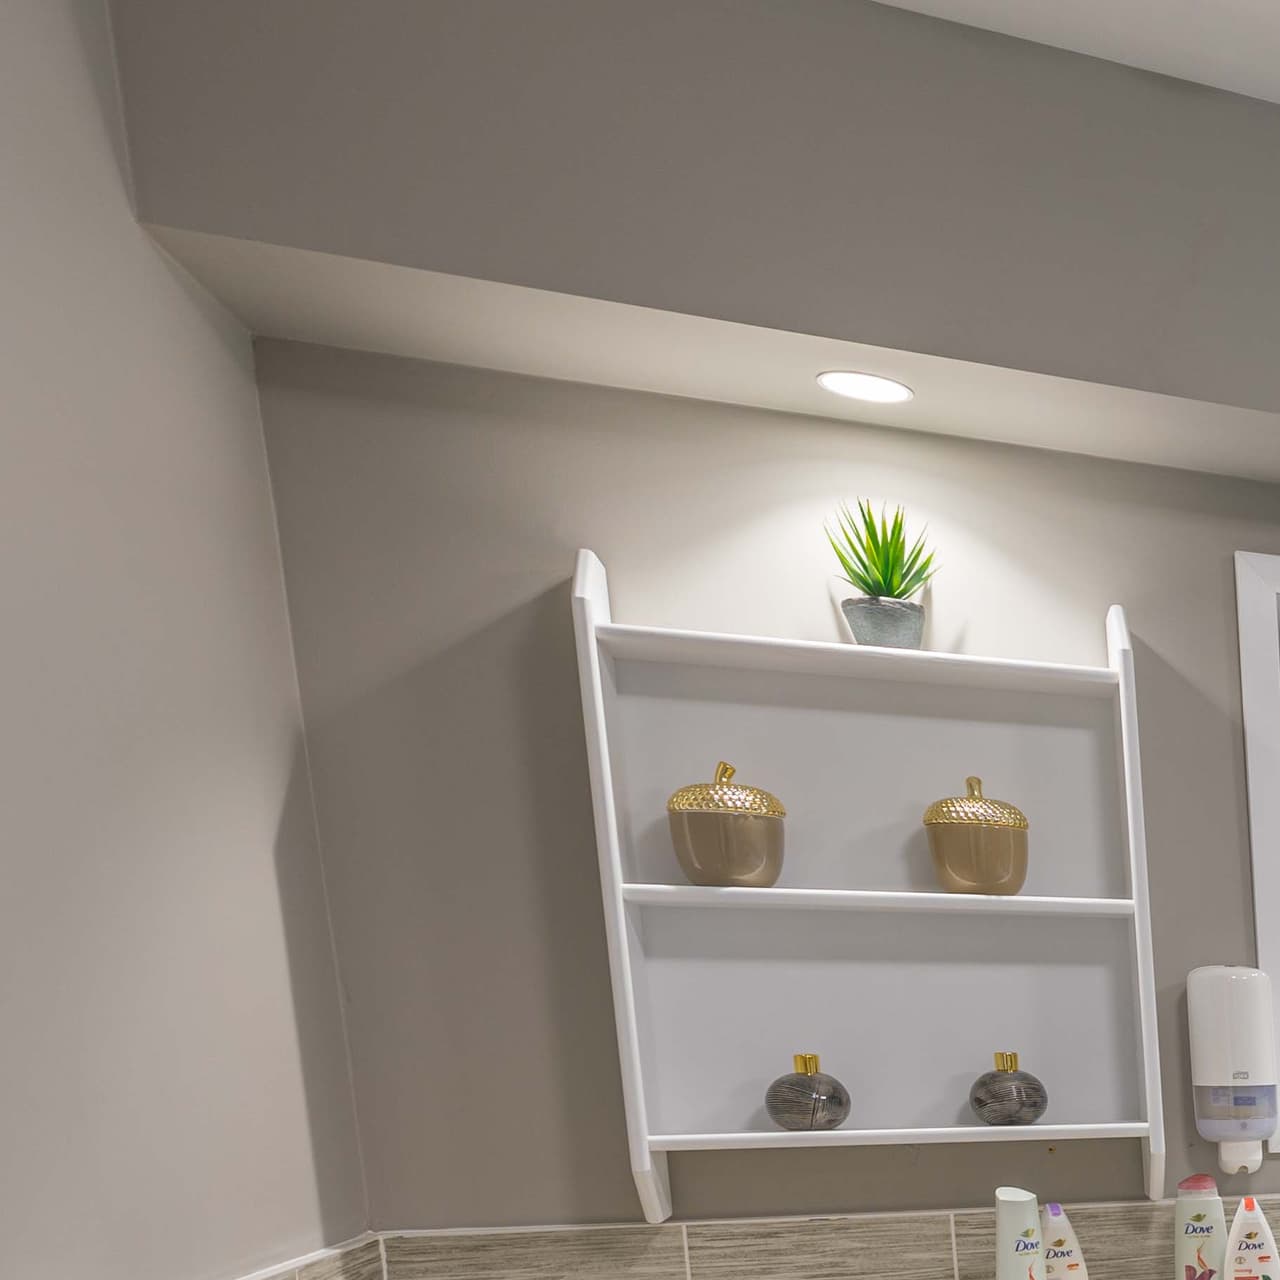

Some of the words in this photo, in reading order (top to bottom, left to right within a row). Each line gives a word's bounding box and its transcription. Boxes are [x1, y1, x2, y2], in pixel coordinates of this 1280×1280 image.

[1184, 1223, 1214, 1235] Dove
[1015, 1239, 1040, 1252] Dove
[1238, 1240, 1265, 1251] Dove
[1045, 1248, 1073, 1259] Dove
